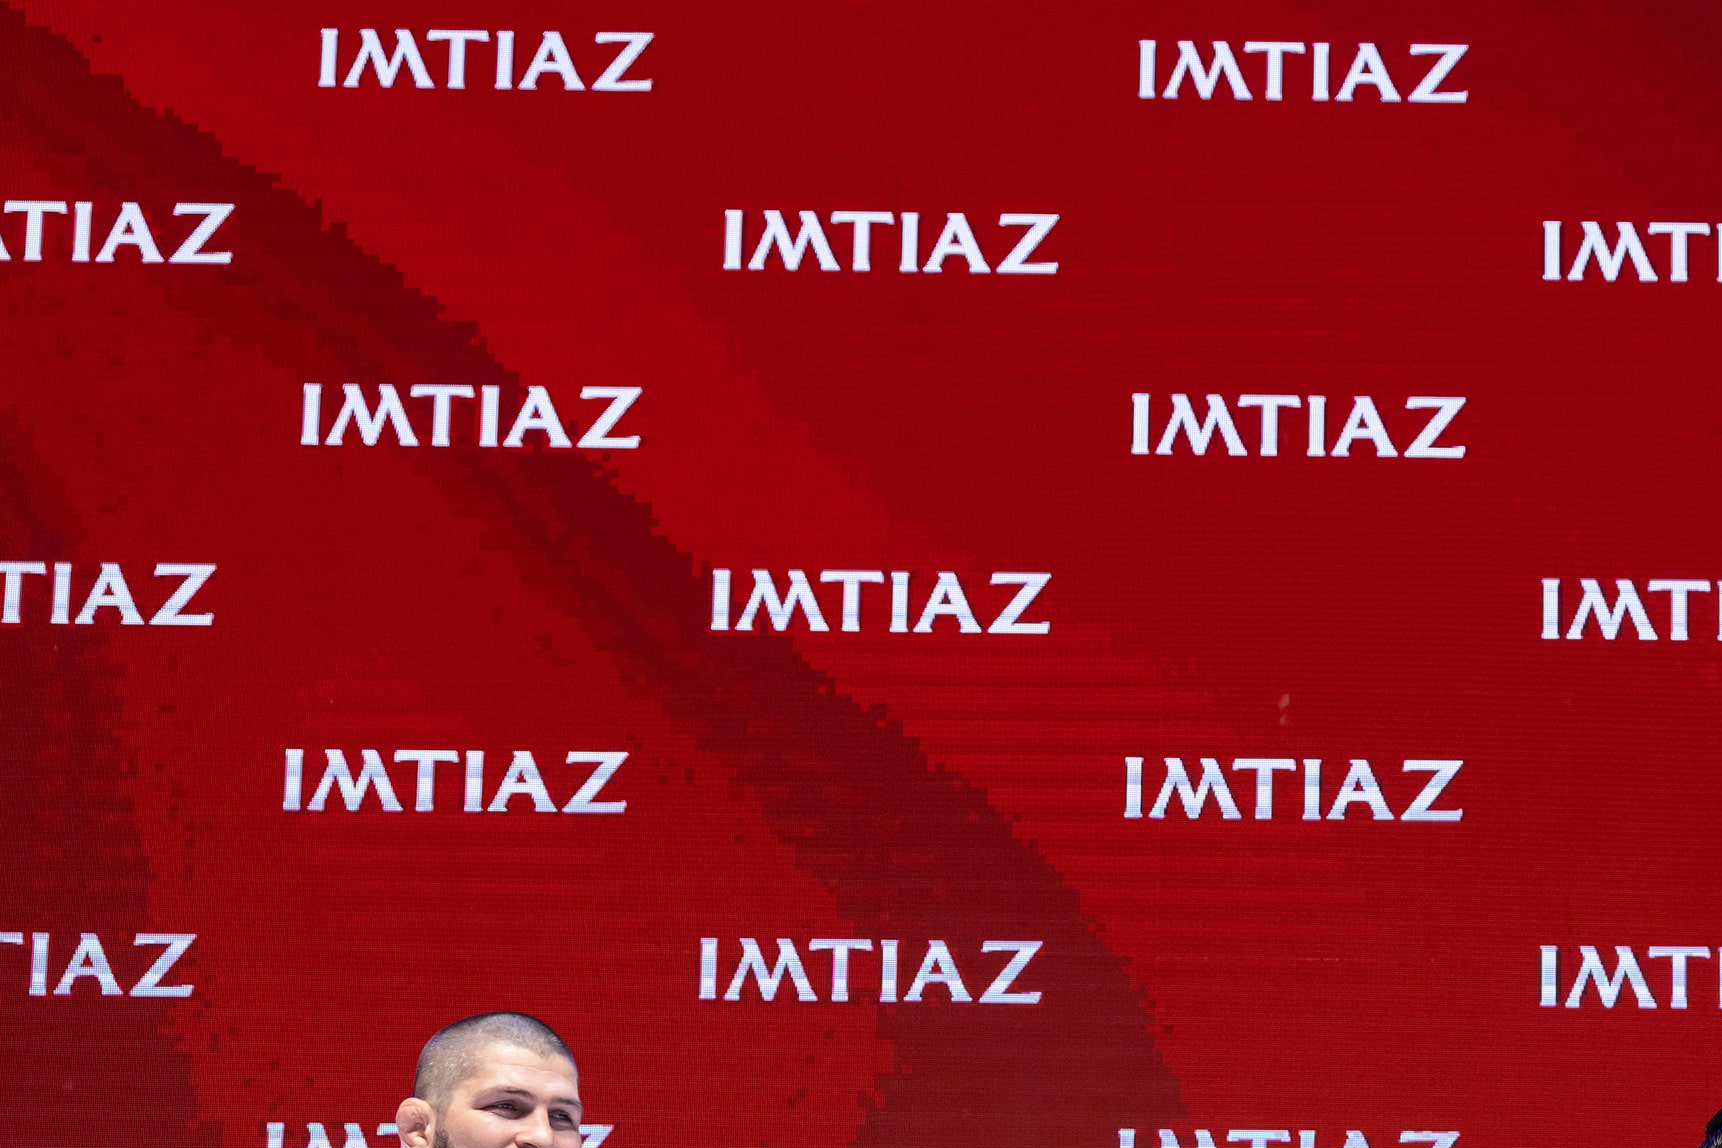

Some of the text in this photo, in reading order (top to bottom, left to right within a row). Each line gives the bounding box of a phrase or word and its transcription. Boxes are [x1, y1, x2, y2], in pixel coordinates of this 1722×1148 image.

[319, 28, 653, 91] IMTIAZ
[1139, 40, 1468, 103] IMTIAZ
[0, 200, 234, 263] TIAZ
[723, 210, 1059, 274] IMTIAZ
[301, 383, 642, 448] IMTIAZ
[1131, 393, 1466, 458] IMTIAZ
[0, 561, 217, 625] TIAZ
[711, 570, 1051, 634] IMTIAZ
[283, 749, 629, 812] IMTIAZ
[1124, 757, 1463, 821] IMTIAZ
[0, 932, 197, 997] IAZ
[699, 938, 1042, 1003] IMTIAZ
